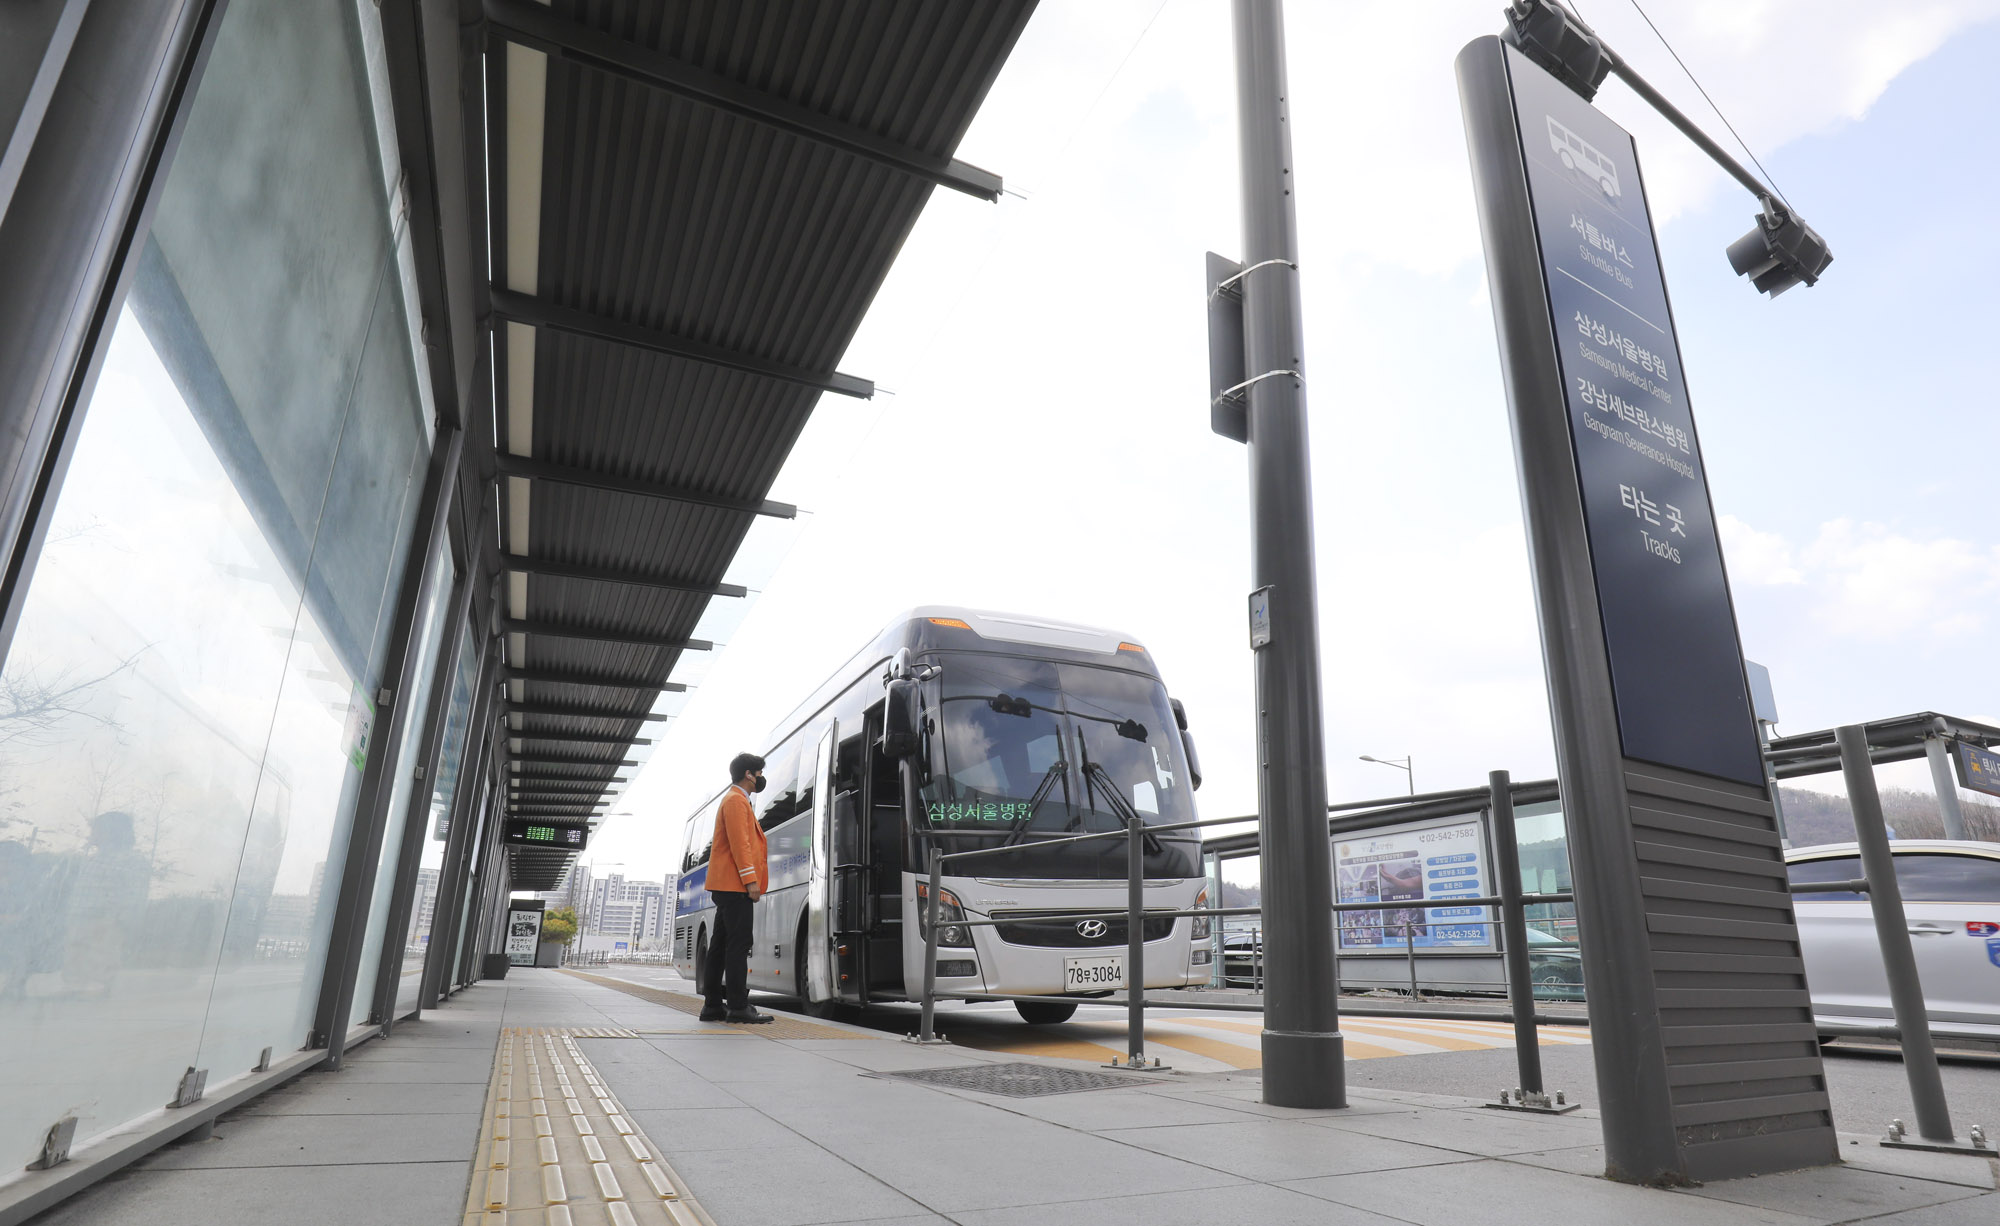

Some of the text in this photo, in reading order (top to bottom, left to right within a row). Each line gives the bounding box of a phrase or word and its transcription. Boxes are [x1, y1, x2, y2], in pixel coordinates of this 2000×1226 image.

[1570, 213, 1634, 269] 셔틀버스
[1579, 244, 1634, 289] Shuttle Bus
[1574, 310, 1669, 382] 삼성서울병원
[1579, 342, 1672, 405] Samsung Medical Center
[1577, 377, 1690, 455] 강남세브란스병원
[1583, 411, 1695, 480] Gangnam Severance Hospital
[1619, 483, 1686, 538] 타는 곳
[1640, 529, 1681, 565] Tracks
[928, 803, 1032, 821] 삼성서울병원
[1426, 828, 1475, 842] 02-542-7582
[1436, 930, 1481, 940] 02-542-7582
[1068, 965, 1122, 984] 78무3084
